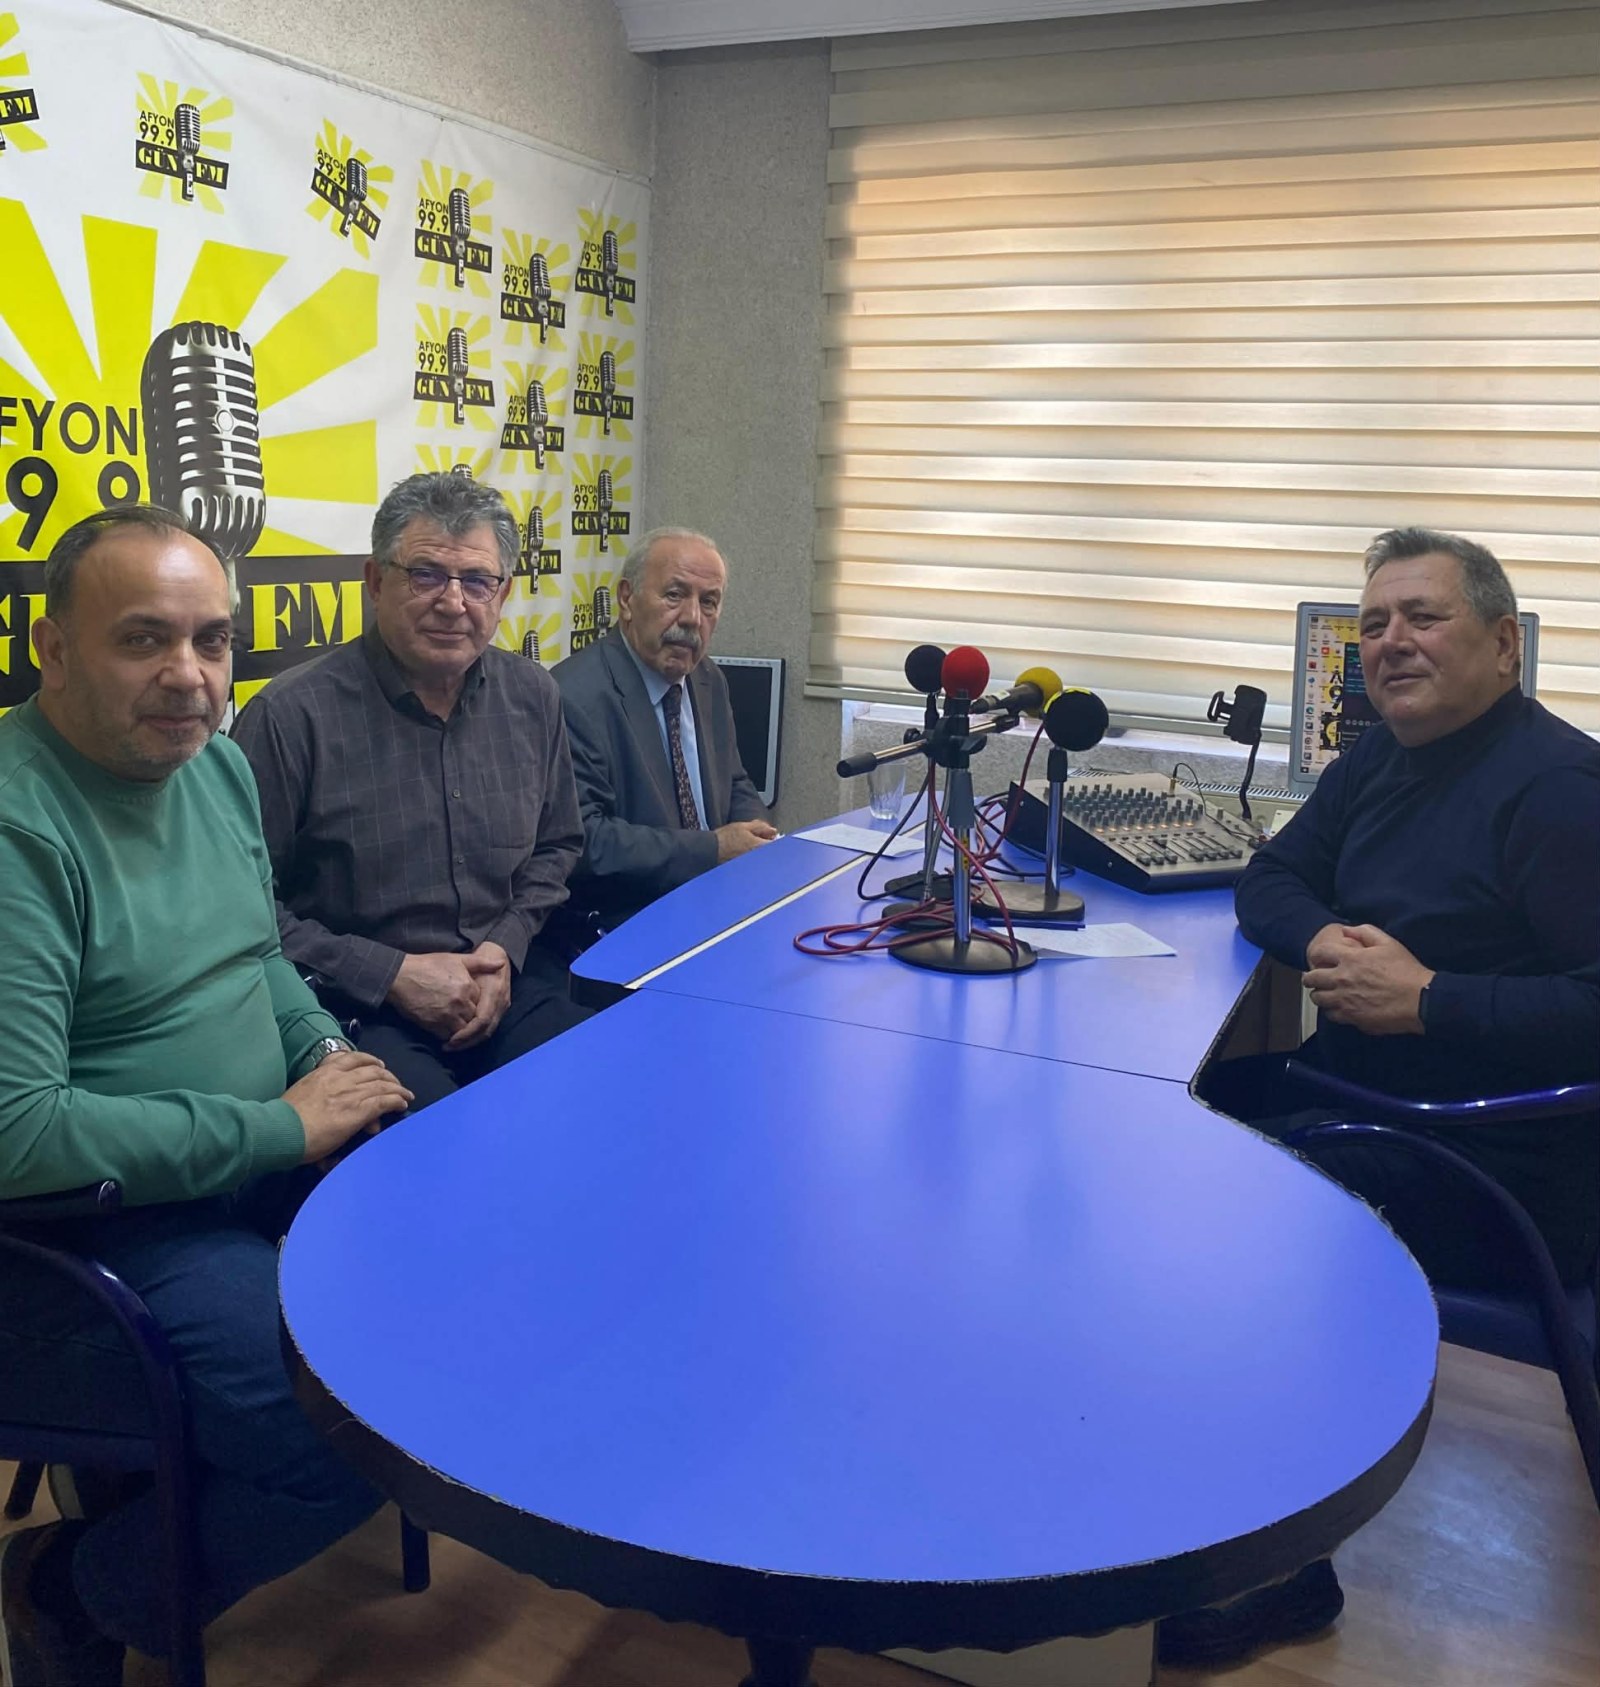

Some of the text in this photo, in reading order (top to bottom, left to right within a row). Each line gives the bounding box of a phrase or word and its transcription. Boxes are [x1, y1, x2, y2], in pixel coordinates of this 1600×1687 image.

[140, 110, 174, 129] AFYON
[140, 121, 174, 146] 99.9
[317, 149, 346, 172] AFYON
[196, 162, 224, 183] FM
[317, 156, 345, 185] 99.9
[419, 198, 448, 214] AFYON
[356, 208, 377, 234] FM
[419, 209, 448, 233] 99.9
[467, 247, 489, 267] FM
[504, 264, 529, 278] AFYON
[504, 275, 529, 295] 99.9
[615, 281, 633, 298] FM
[419, 340, 447, 354] AFYON
[418, 352, 447, 373] 99.9
[578, 363, 600, 375] AFYON
[577, 373, 600, 391] 99.9
[466, 384, 490, 401] FM
[612, 400, 631, 415] FM
[0, 396, 138, 456] FYON
[574, 485, 598, 494] AFYON
[574, 494, 598, 510] 99.9
[610, 516, 627, 530] FM
[246, 581, 366, 653] FM
[573, 612, 593, 629] 99.9
